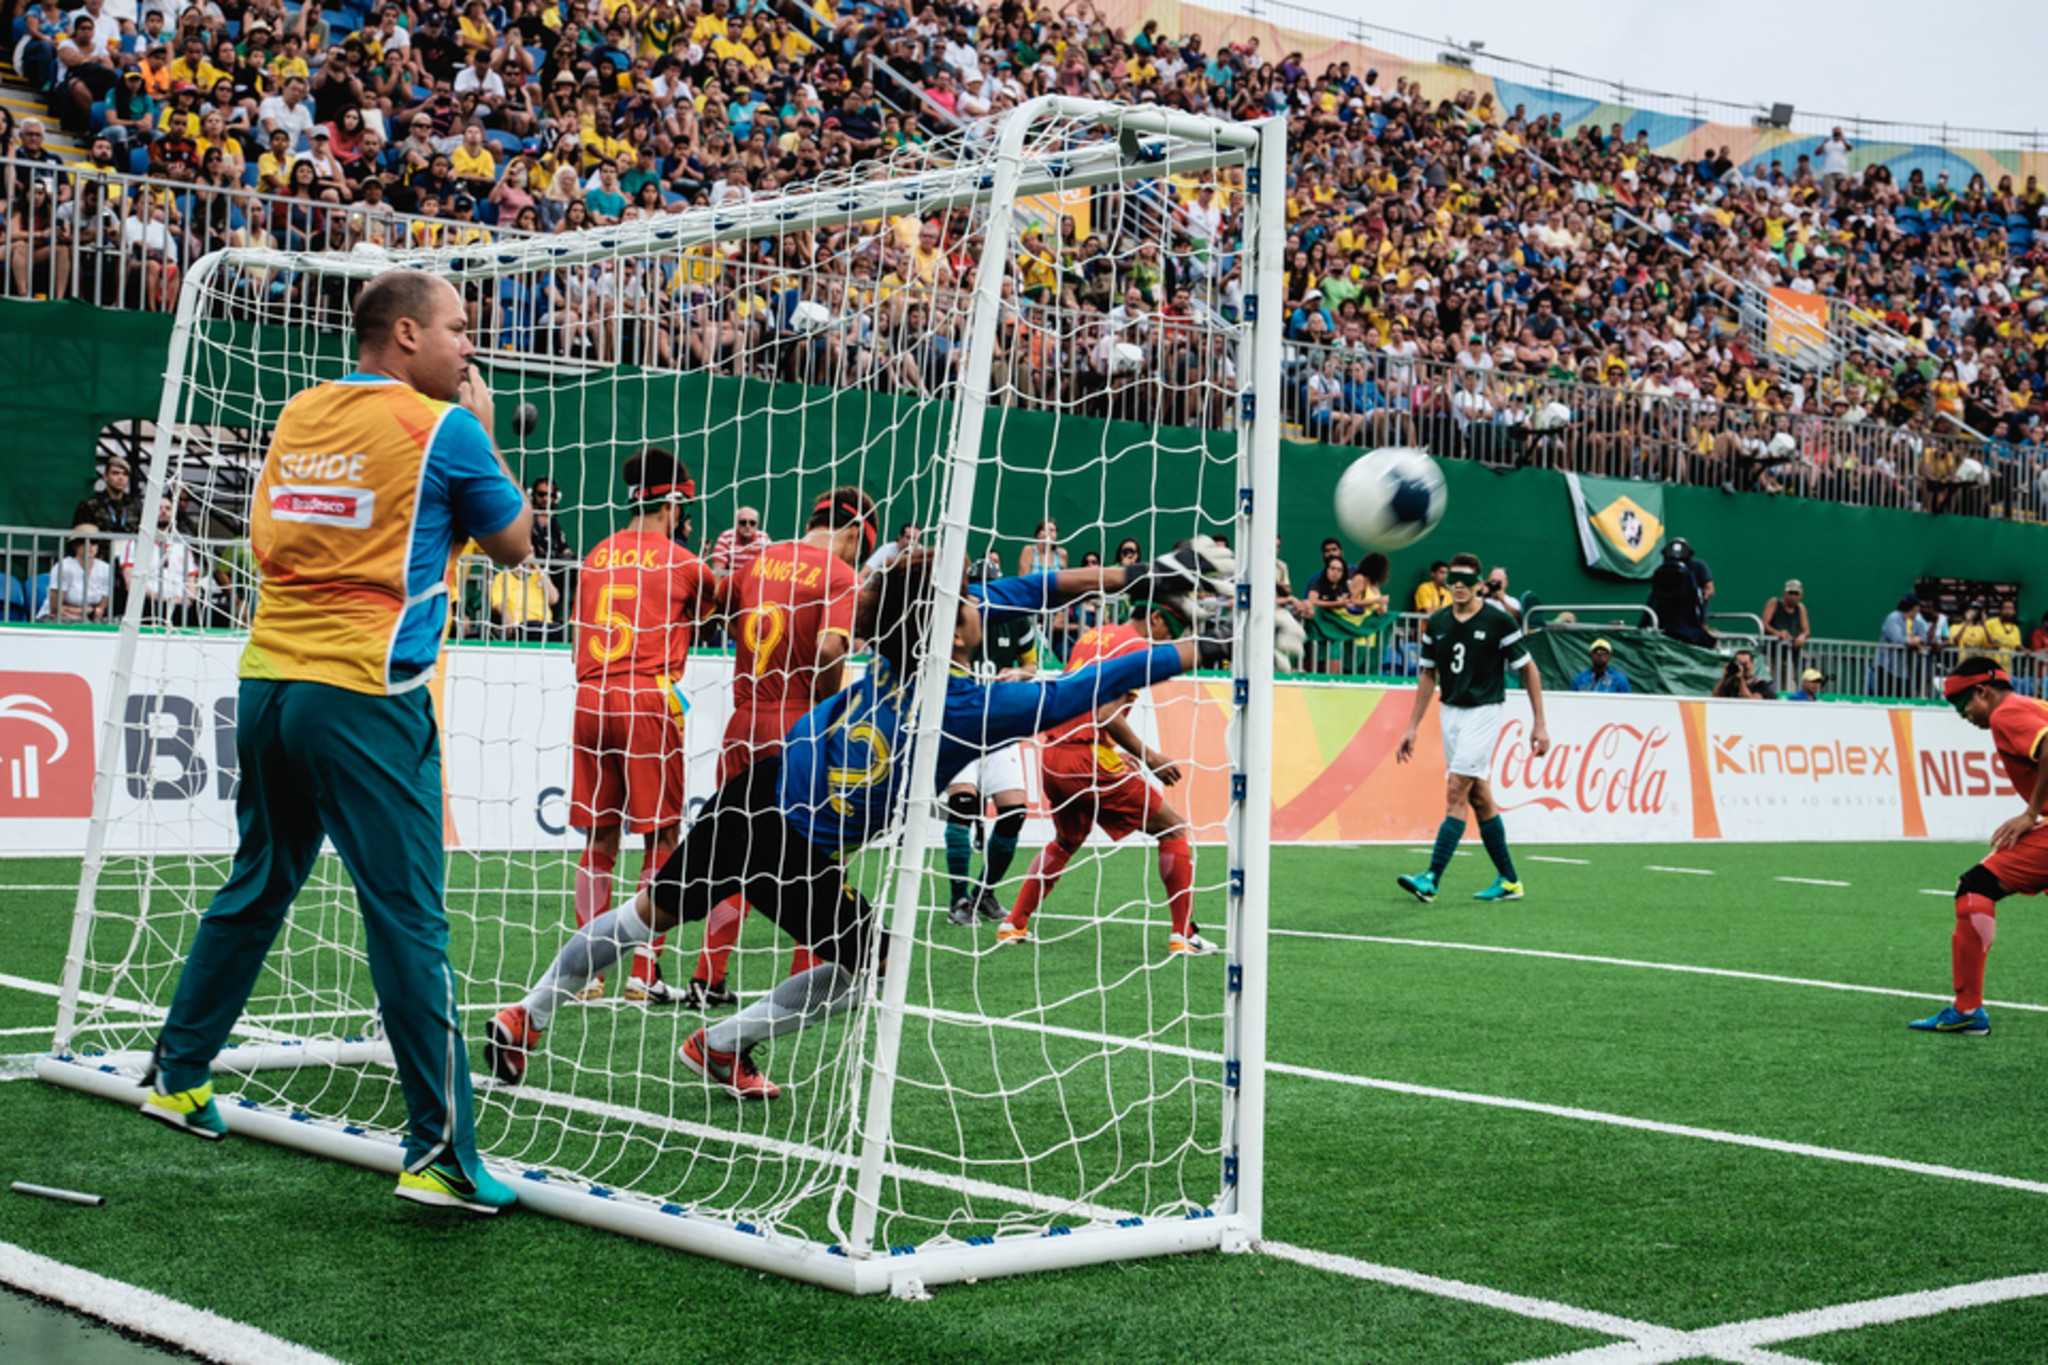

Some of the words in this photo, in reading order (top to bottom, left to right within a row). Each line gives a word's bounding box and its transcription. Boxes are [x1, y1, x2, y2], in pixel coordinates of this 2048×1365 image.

[280, 453, 367, 481] GUIDE
[594, 547, 638, 568] GAO
[588, 584, 638, 664] 5
[743, 601, 784, 677] 9
[1450, 642, 1466, 675] 3
[1487, 718, 1671, 814] Coca-Cola
[1713, 735, 1892, 782] Kinoplex
[1719, 794, 1788, 807] CINEMA
